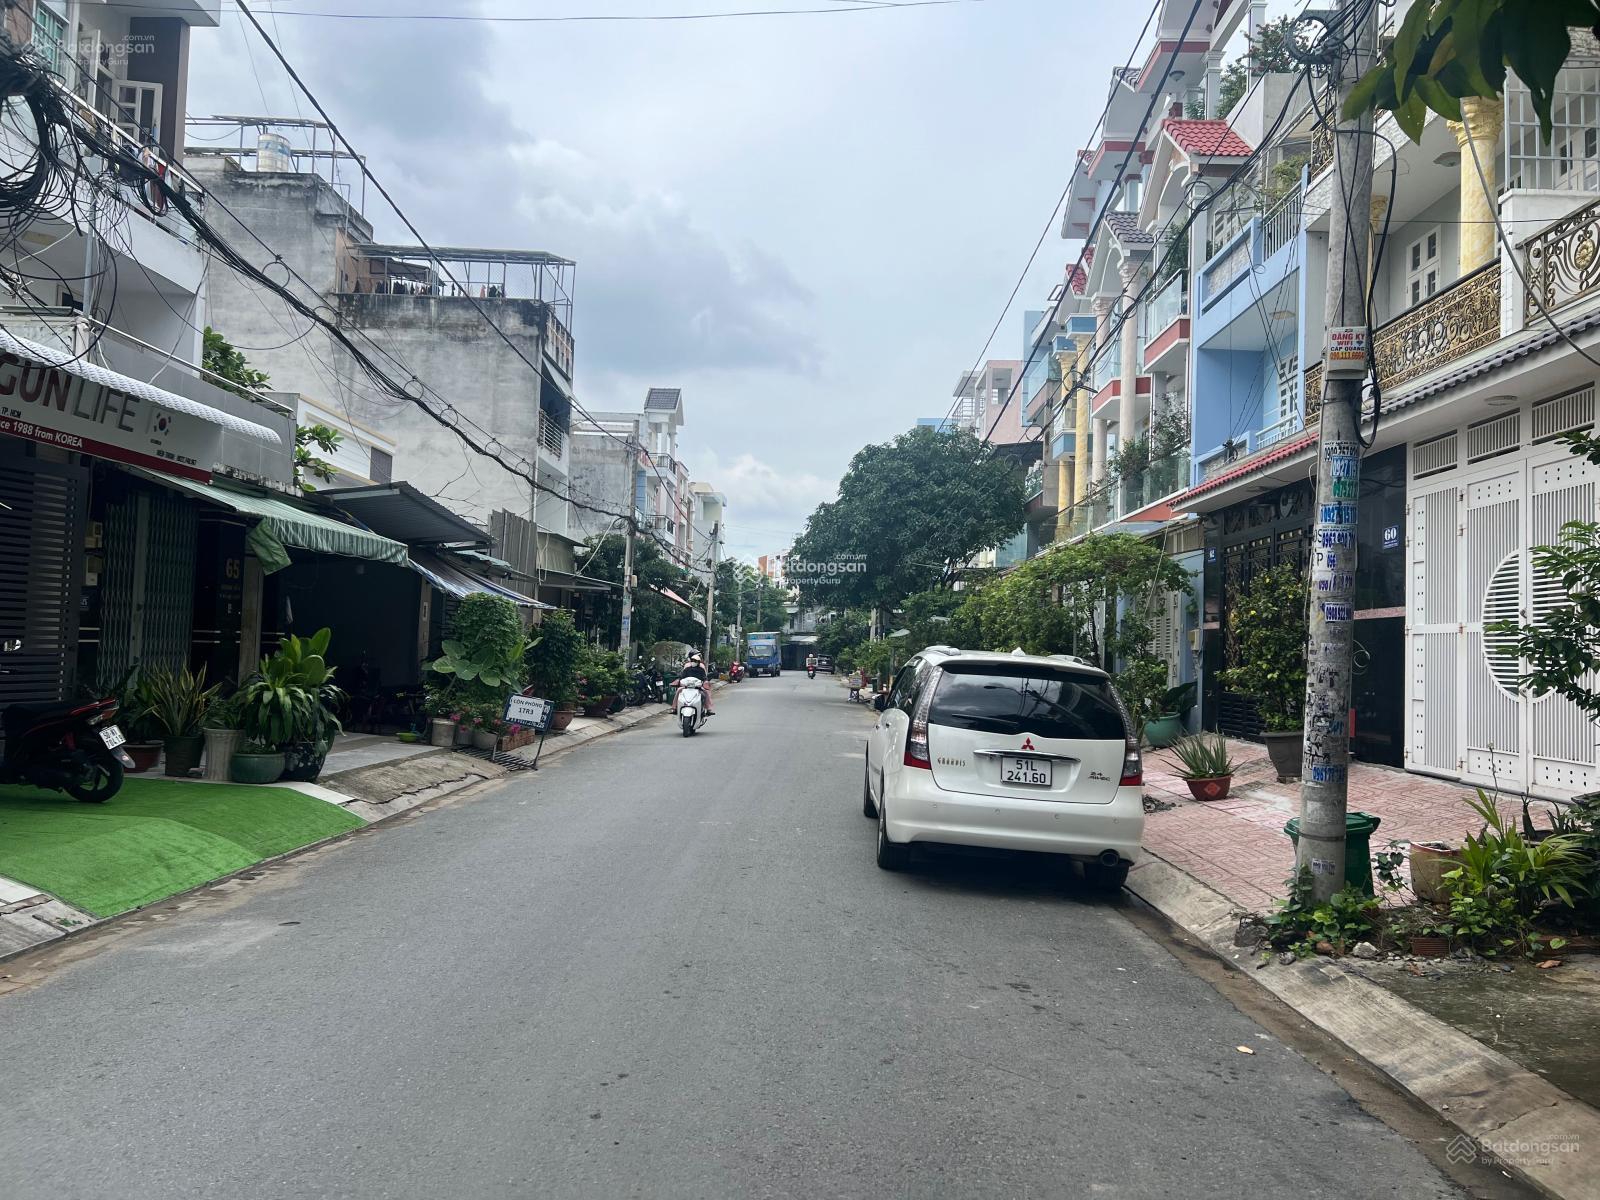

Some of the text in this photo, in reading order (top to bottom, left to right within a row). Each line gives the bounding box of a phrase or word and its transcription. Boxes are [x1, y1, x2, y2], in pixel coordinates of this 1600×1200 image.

[13, 421, 33, 436] 1988
[34, 430, 54, 442] from
[54, 432, 84, 449] KOREA
[1384, 527, 1397, 541] 60
[1016, 759, 1038, 772] 51L
[1007, 770, 1046, 784] 241.60
